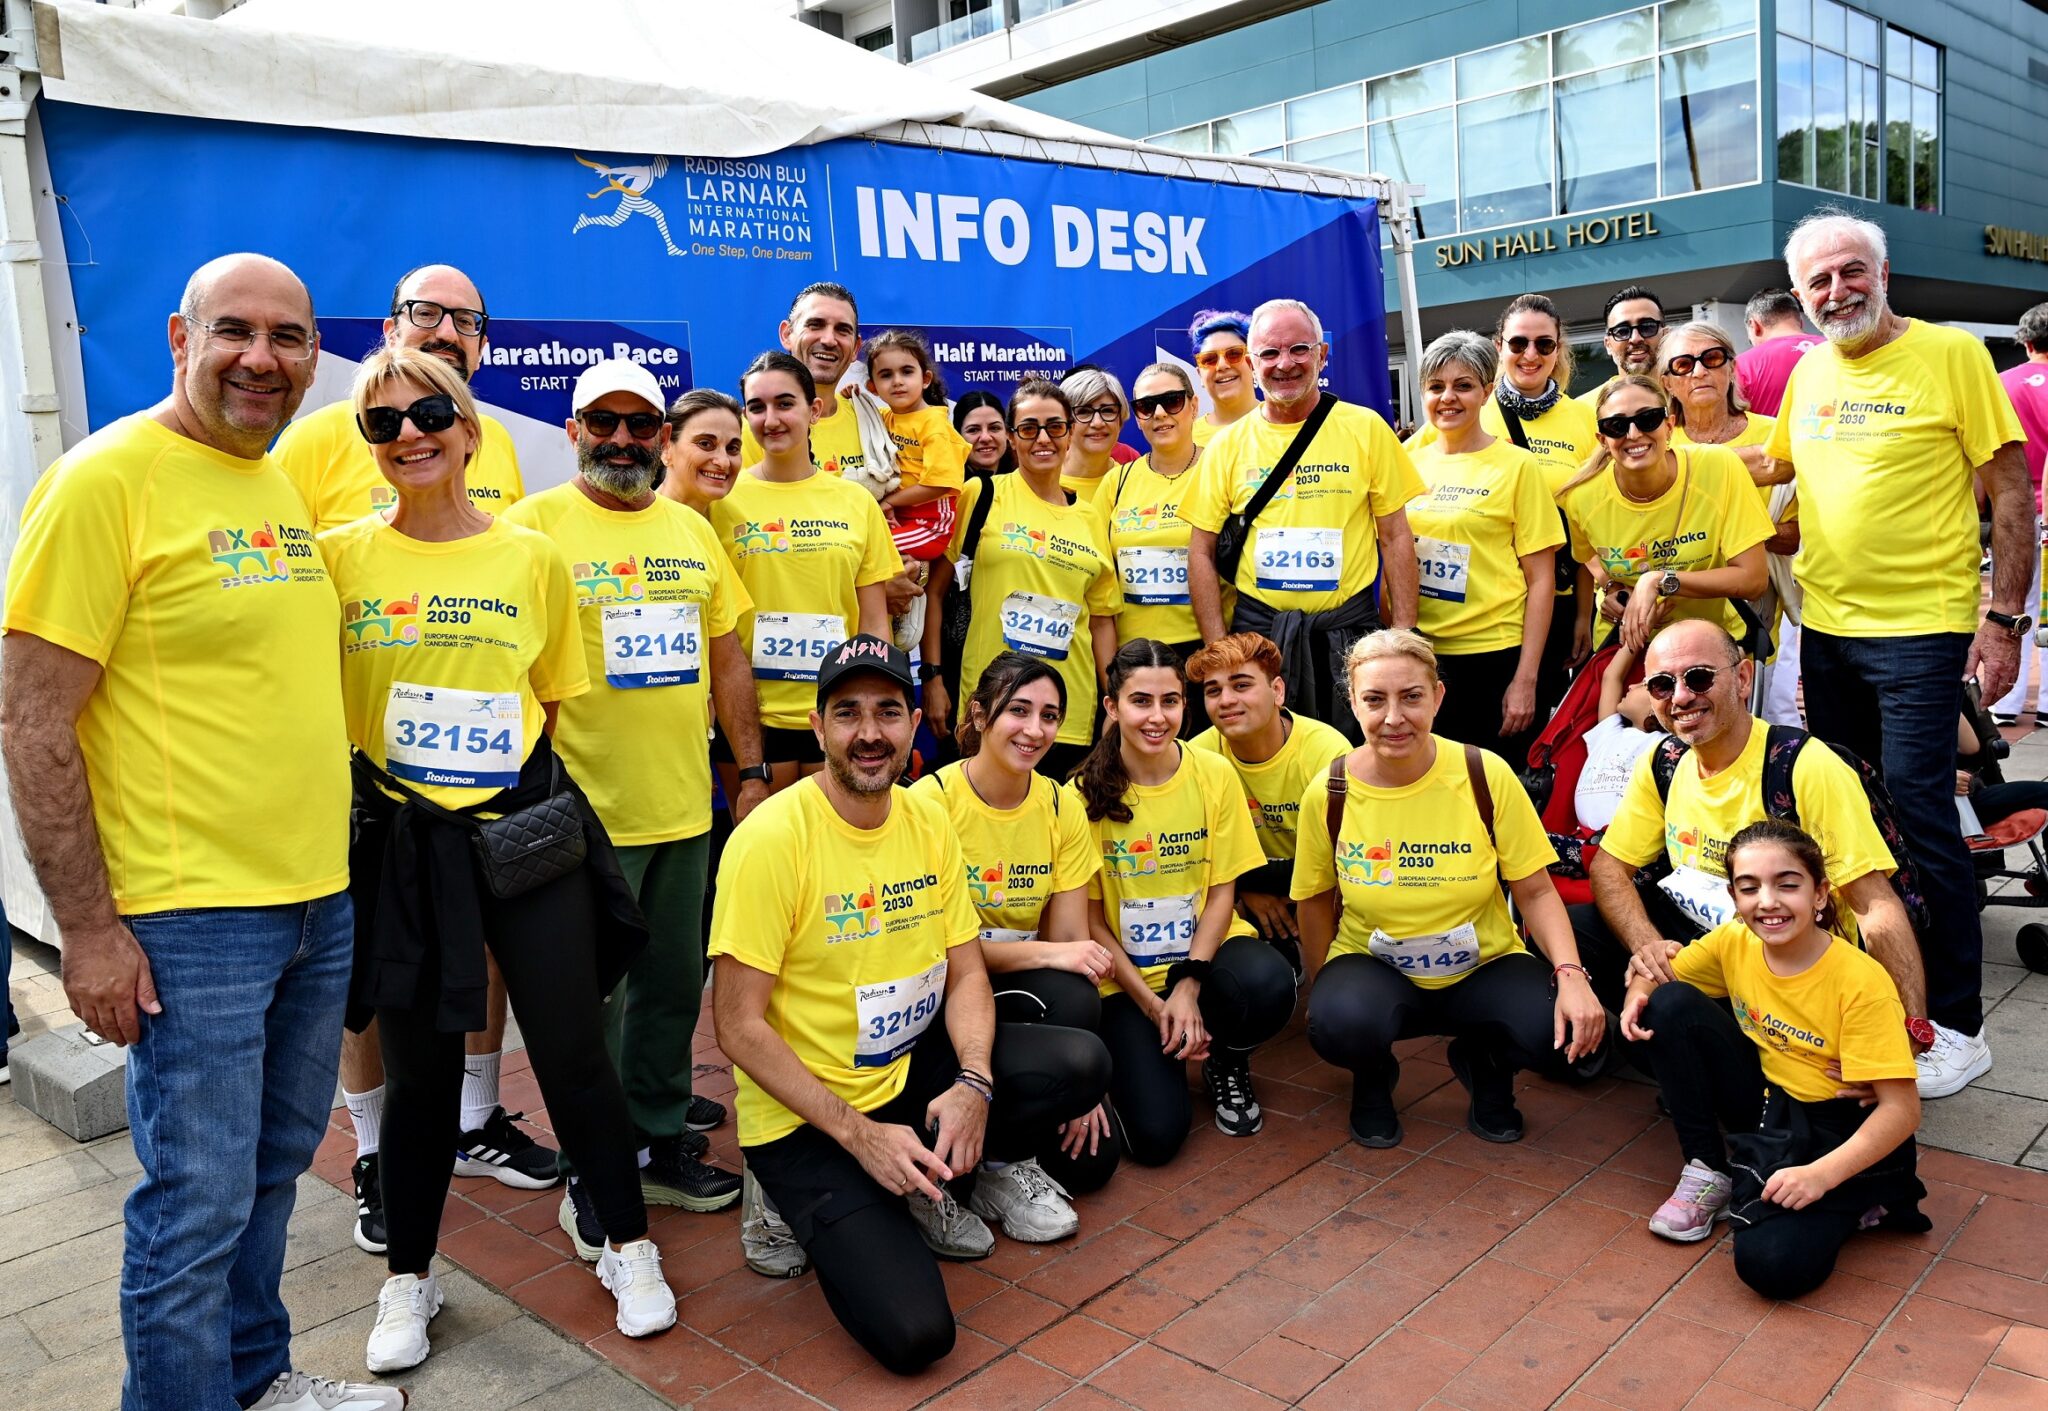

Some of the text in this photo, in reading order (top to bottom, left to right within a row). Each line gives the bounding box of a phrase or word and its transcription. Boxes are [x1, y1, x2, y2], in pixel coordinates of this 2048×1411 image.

[684, 157, 806, 184] RADISSON BLU
[686, 176, 808, 208] LARNAKA
[688, 203, 810, 223] INTERNATIONAL
[689, 218, 811, 243] MARATHON
[856, 185, 1208, 277] INFO DESK
[1436, 211, 1659, 268] SUN HALL HOTEL
[691, 243, 812, 261] One Step, One Dream
[613, 342, 679, 365] Race
[934, 342, 1065, 362] Half Marathon
[520, 376, 568, 391] START
[964, 370, 995, 382] START
[998, 370, 1021, 382] TIME
[1838, 414, 1866, 425] 2030
[1531, 446, 1550, 455] 030
[1296, 474, 1321, 485] 2030
[791, 529, 822, 538] 2030
[284, 543, 312, 558] 2030
[1050, 543, 1074, 557] 2030
[1261, 550, 1335, 568] 32163
[645, 570, 681, 582] 2030
[1124, 567, 1188, 583] 32139
[1417, 557, 1461, 580] 137
[426, 610, 471, 625] 2030
[1006, 610, 1069, 639] 32140
[424, 633, 458, 641] EUROPEAN
[459, 634, 483, 643] CAPITAL
[424, 640, 459, 648] CANDIDATE
[614, 632, 697, 658] 32145
[395, 719, 512, 755] 32154
[424, 771, 475, 785] Stoiximan
[1264, 813, 1283, 823] 030
[1158, 827, 1209, 844] Λarnak
[1159, 844, 1190, 857] 2030
[1398, 856, 1434, 868] 2030
[1008, 877, 1035, 889] 2030
[882, 894, 913, 912] 2030
[1380, 950, 1471, 969] 32142
[869, 991, 937, 1040] 32150
